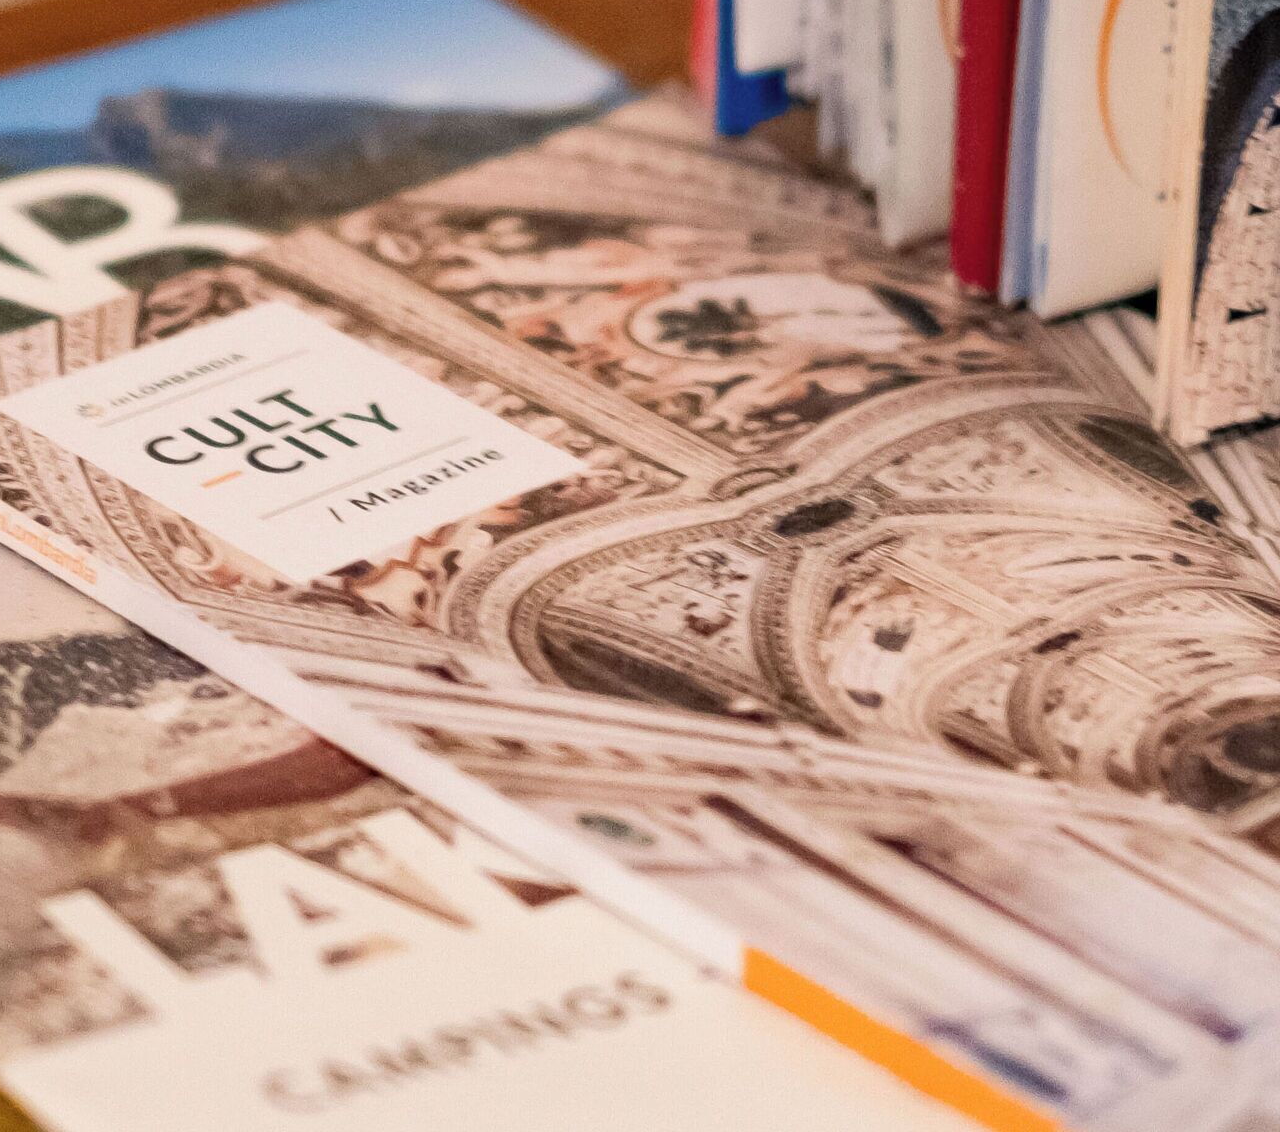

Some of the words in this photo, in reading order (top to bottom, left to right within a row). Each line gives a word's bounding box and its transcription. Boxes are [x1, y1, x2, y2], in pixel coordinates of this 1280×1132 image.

[144, 388, 318, 468] CULT
[246, 401, 402, 476] CITY
[351, 445, 507, 513] Magazine
[261, 972, 672, 1115] CAMPINGS
